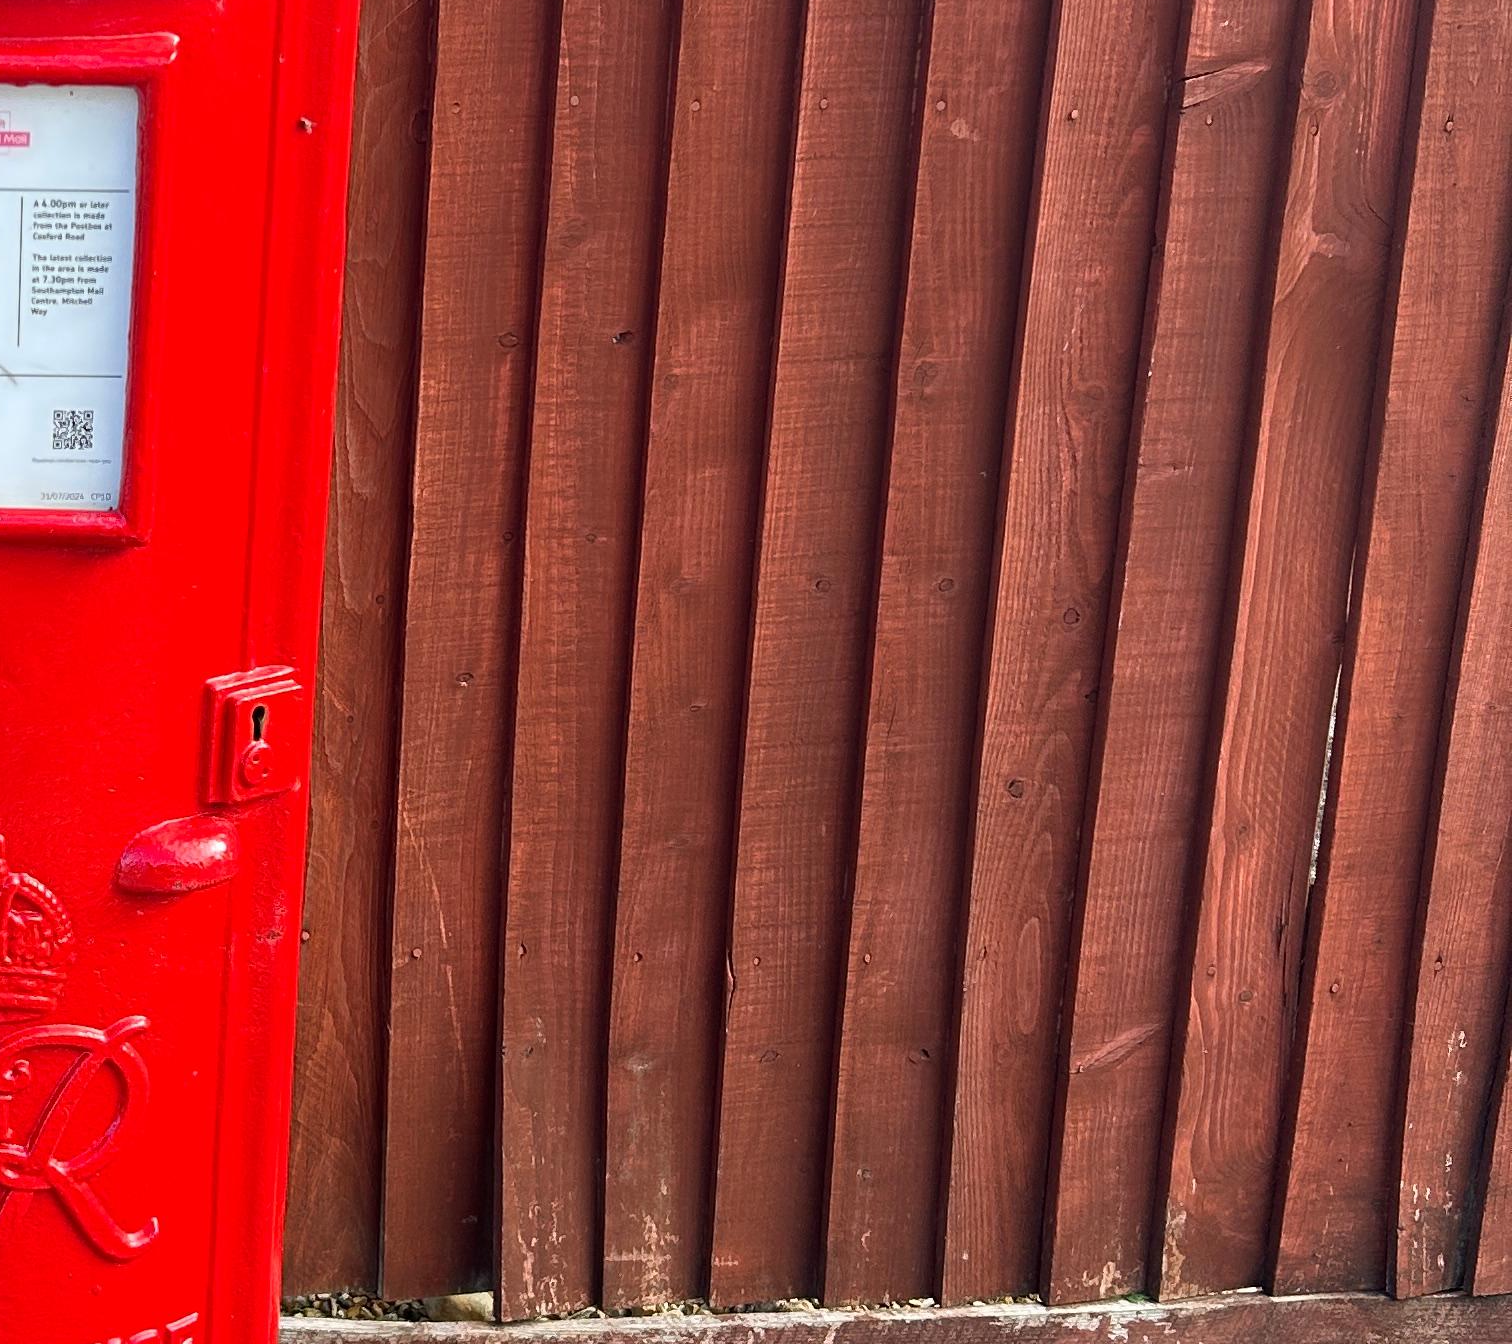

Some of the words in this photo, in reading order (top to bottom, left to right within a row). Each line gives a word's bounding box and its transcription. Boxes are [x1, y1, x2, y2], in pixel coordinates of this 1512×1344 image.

[3, 133, 27, 145] Mail
[33, 199, 39, 208] A
[90, 201, 110, 209] later
[33, 222, 52, 230] from
[55, 222, 68, 230] the
[71, 222, 102, 230] Postbox
[75, 254, 113, 262] collection
[87, 265, 109, 273] made
[43, 276, 75, 285] 7.30pm
[78, 276, 96, 284] from
[32, 287, 84, 295] Southampton
[88, 287, 104, 295] Mail
[31, 308, 48, 316] Way
